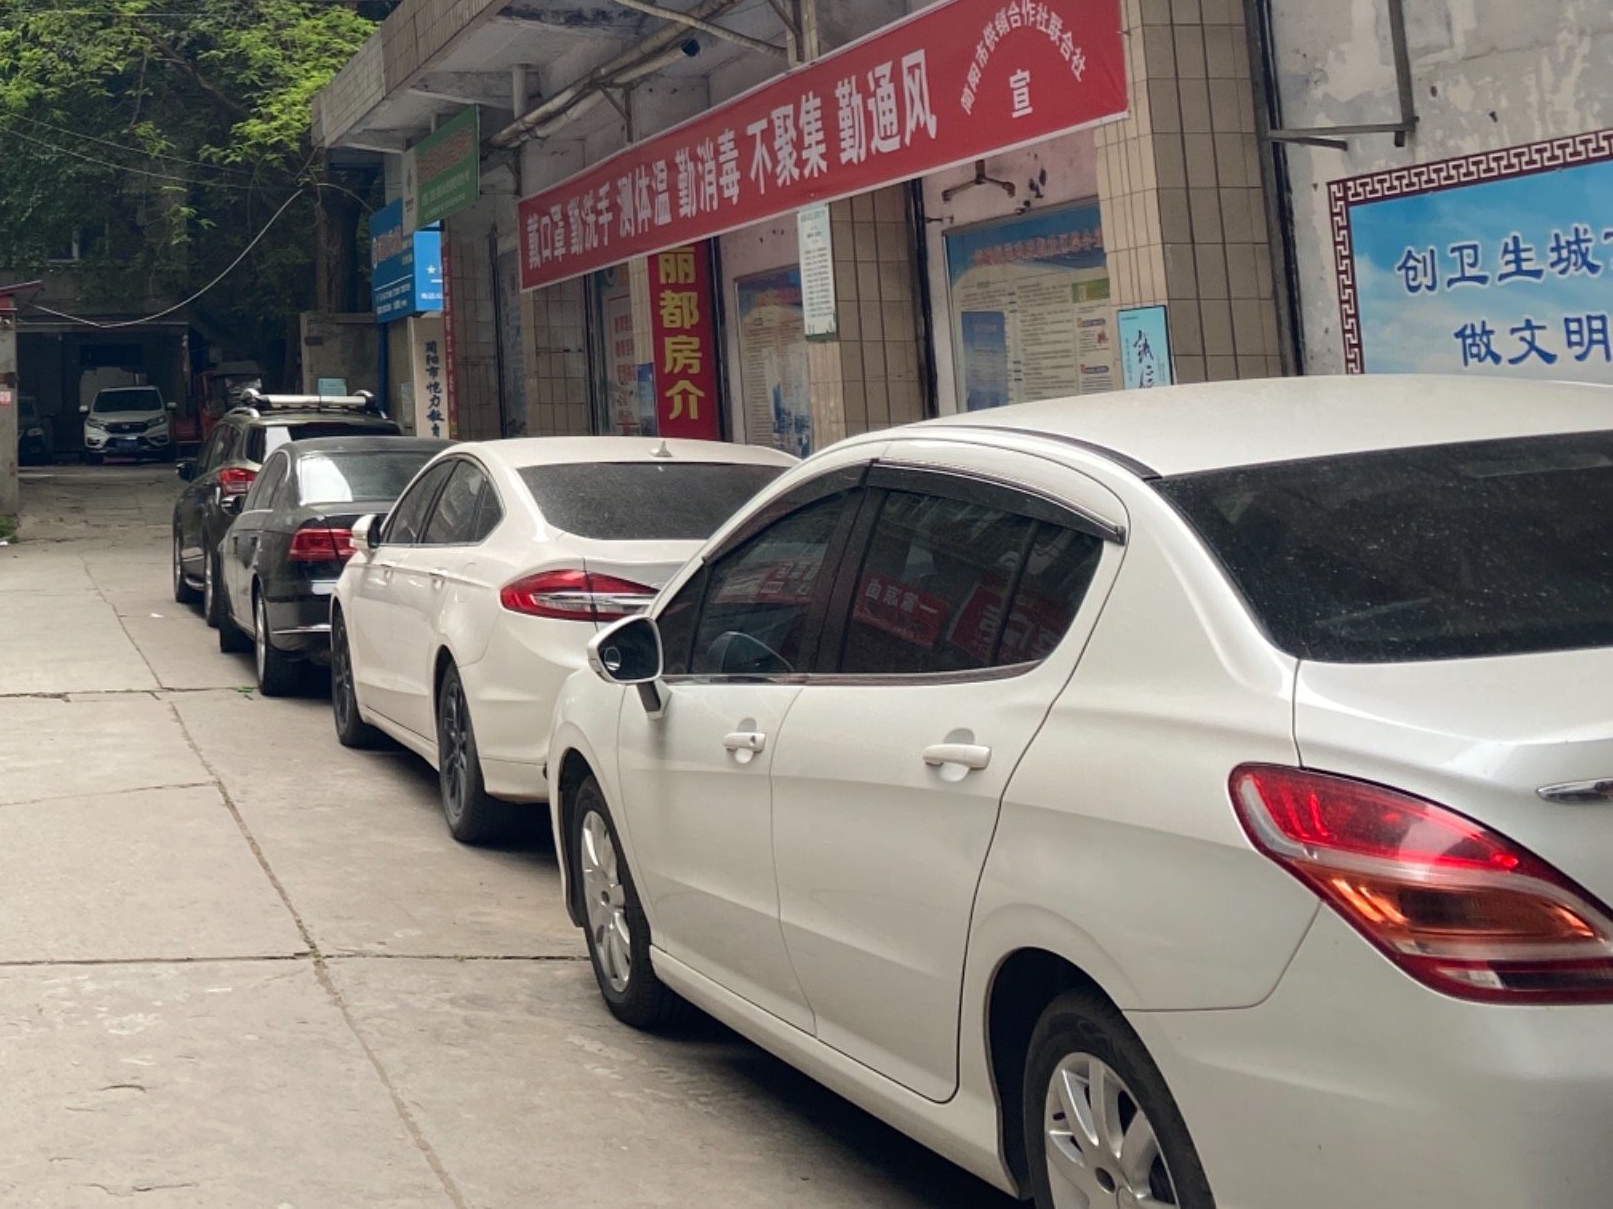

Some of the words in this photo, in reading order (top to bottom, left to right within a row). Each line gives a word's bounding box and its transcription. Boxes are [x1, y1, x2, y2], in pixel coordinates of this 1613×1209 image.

[1009, 69, 1034, 119] 宣
[526, 211, 566, 270] 戴口罩
[567, 181, 614, 256] 勤洗手
[617, 158, 672, 238] 测体温
[675, 127, 741, 219] 勤消毒
[746, 90, 828, 195] 不聚集
[835, 48, 937, 166] 勤通风
[1397, 226, 1613, 293] 创卫生城
[657, 245, 706, 421] 丽都房介
[1454, 313, 1612, 367] 做文明
